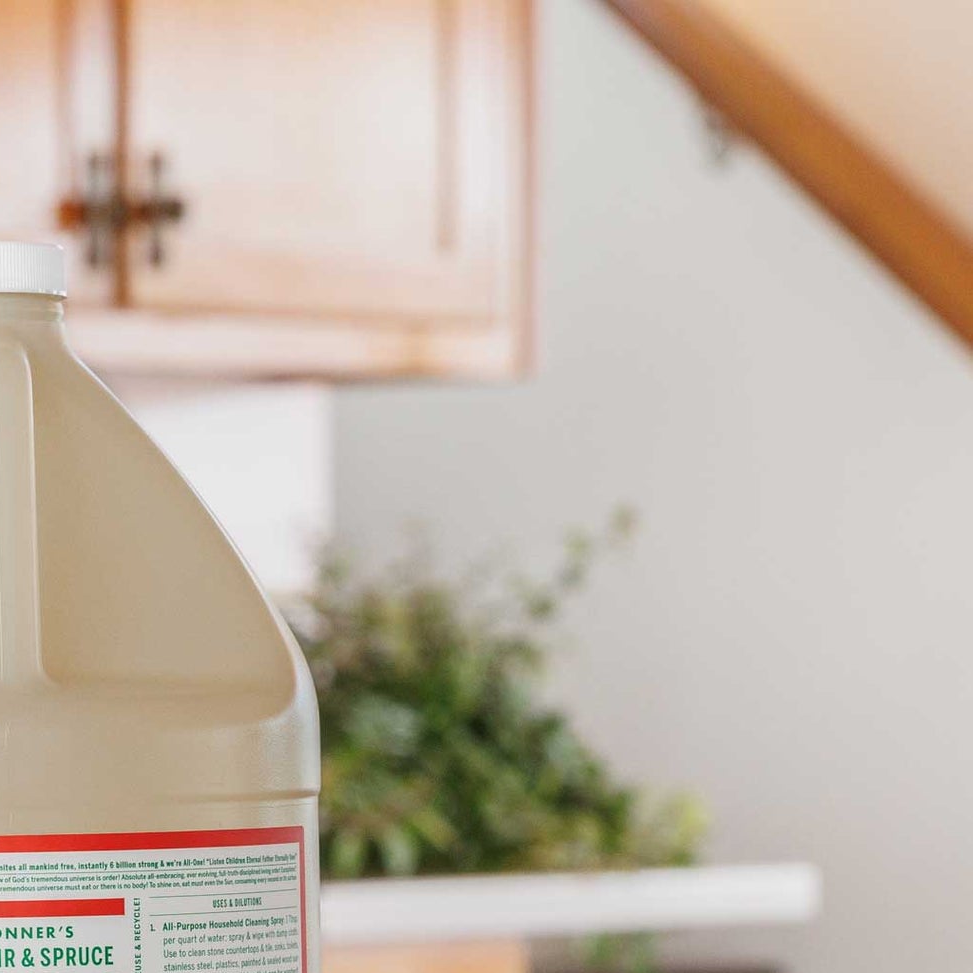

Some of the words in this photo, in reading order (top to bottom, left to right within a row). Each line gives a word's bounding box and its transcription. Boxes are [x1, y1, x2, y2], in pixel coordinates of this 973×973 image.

[18, 863, 27, 871] all
[29, 863, 59, 871] mankind
[78, 862, 108, 870] instantly
[109, 861, 114, 869] 6
[115, 861, 136, 869] billion
[138, 861, 159, 871] strong
[166, 859, 182, 867] we're
[183, 858, 205, 866] All-One!
[212, 899, 227, 908] USES
[229, 899, 233, 907] &
[234, 897, 262, 907] DILUTIONS
[133, 898, 141, 941] RECYCLE!
[150, 924, 155, 932] 1.
[162, 922, 207, 932] All-Purpose
[209, 919, 244, 929] Household
[245, 918, 270, 927] Cleaning
[21, 948, 34, 967] &
[40, 946, 113, 967] SPRUCE
